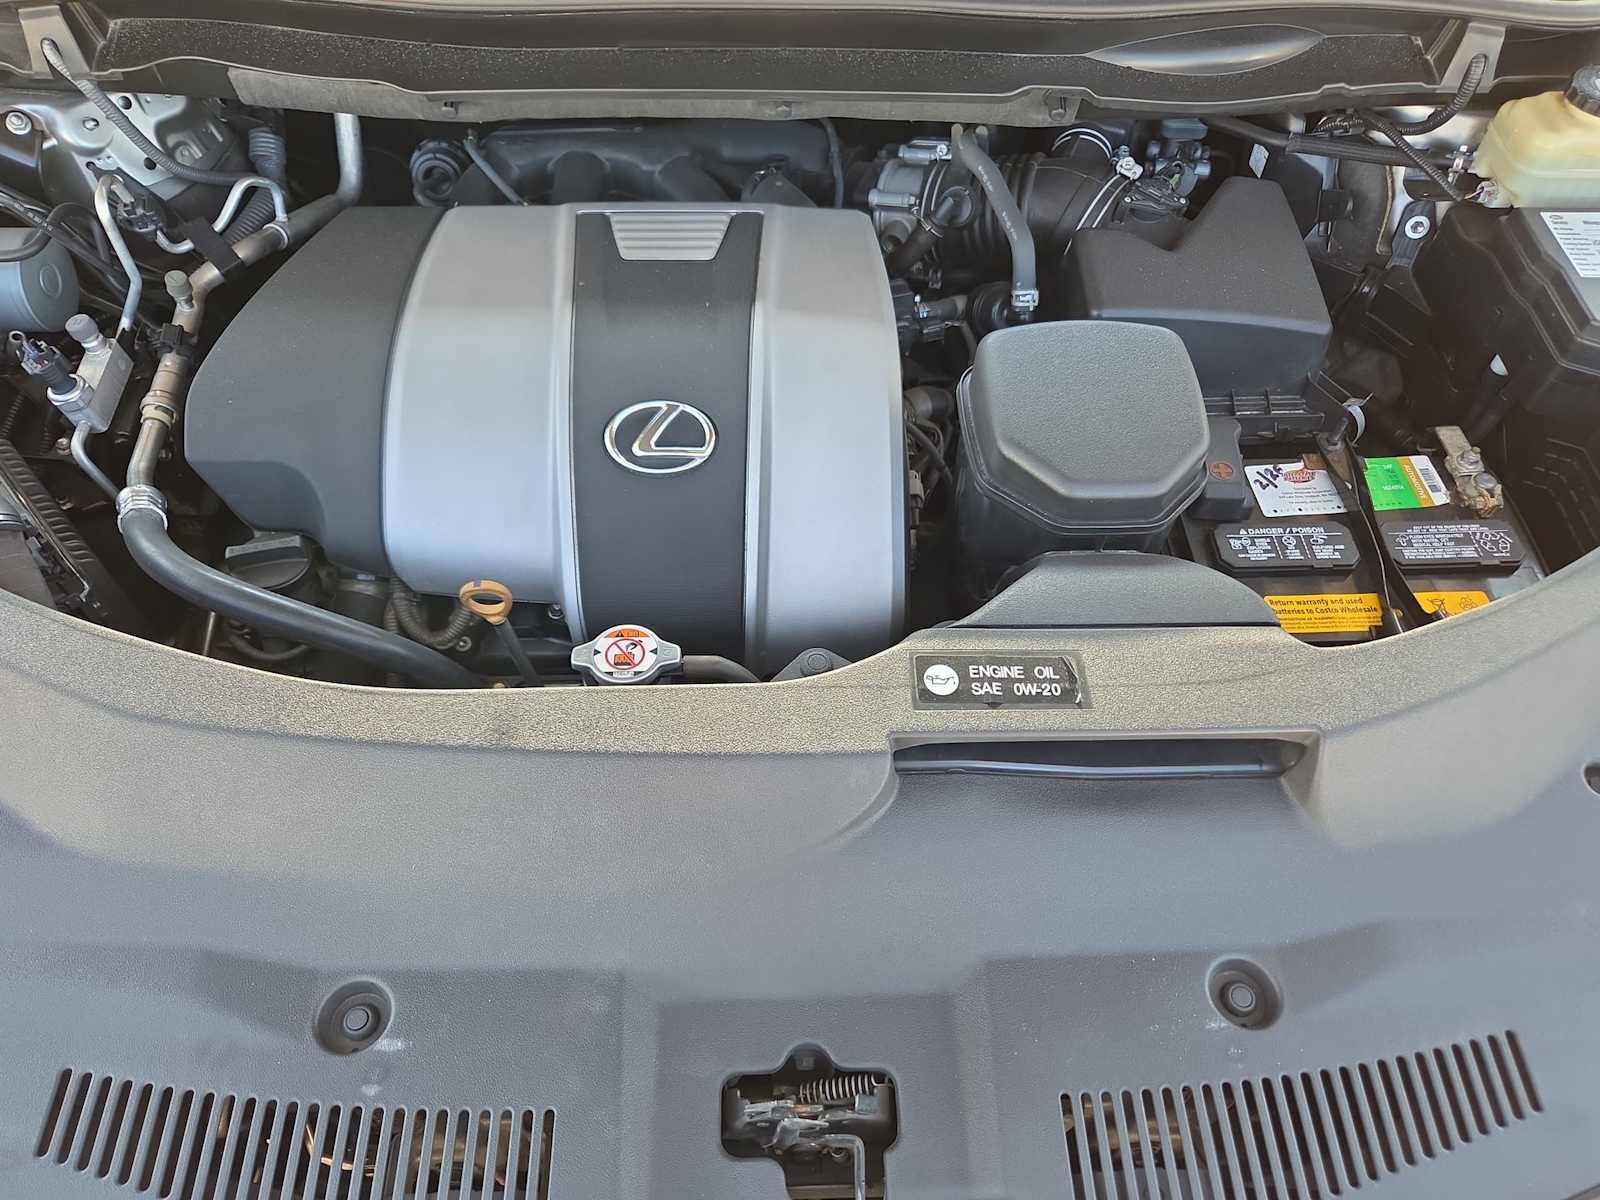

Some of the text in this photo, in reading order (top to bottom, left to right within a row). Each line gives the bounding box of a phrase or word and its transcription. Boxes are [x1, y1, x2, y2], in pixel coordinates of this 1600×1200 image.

[1247, 527, 1284, 535] DANGER
[1292, 526, 1325, 534] POISON
[968, 665, 1060, 679] ENGINE OIL
[971, 682, 1062, 696] SAE 0W-20
